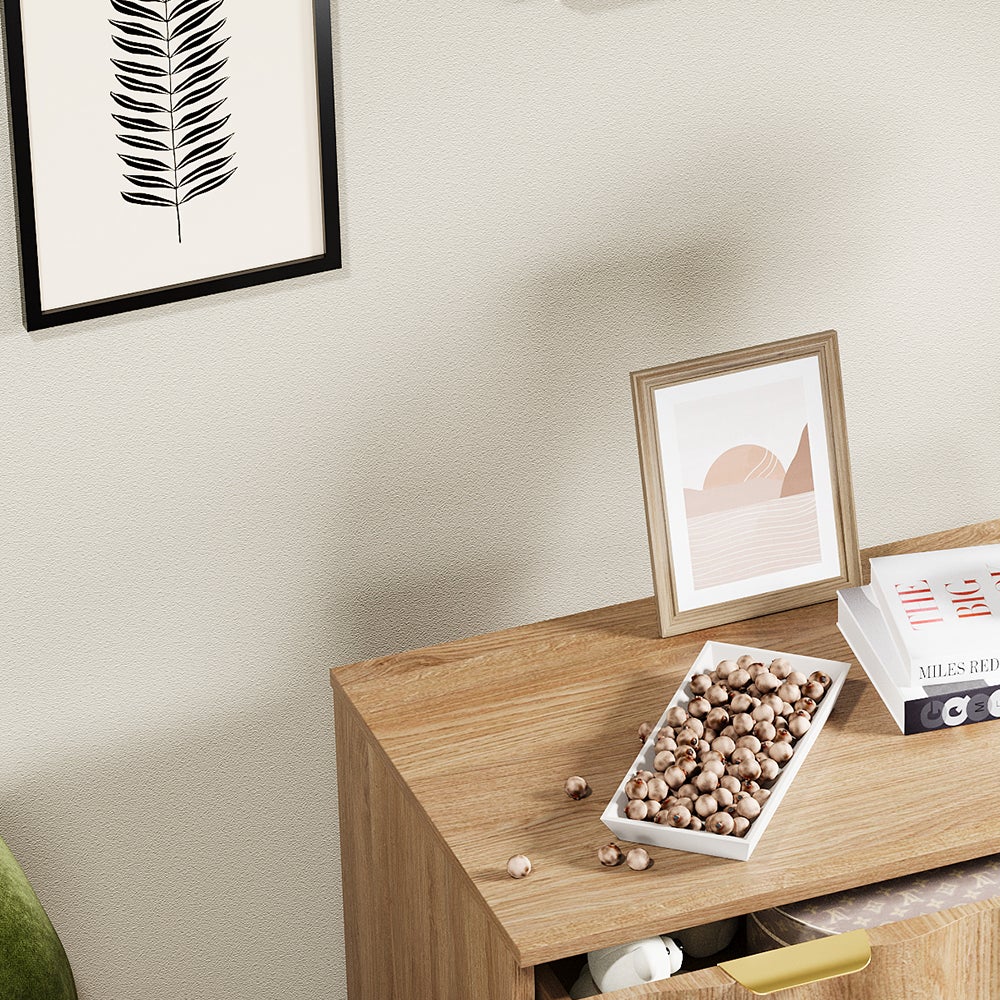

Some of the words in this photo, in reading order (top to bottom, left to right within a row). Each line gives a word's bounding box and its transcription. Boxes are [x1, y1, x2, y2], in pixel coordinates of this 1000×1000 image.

[895, 579, 943, 631] THE
[944, 579, 993, 618] BIG
[918, 662, 966, 680] MILES
